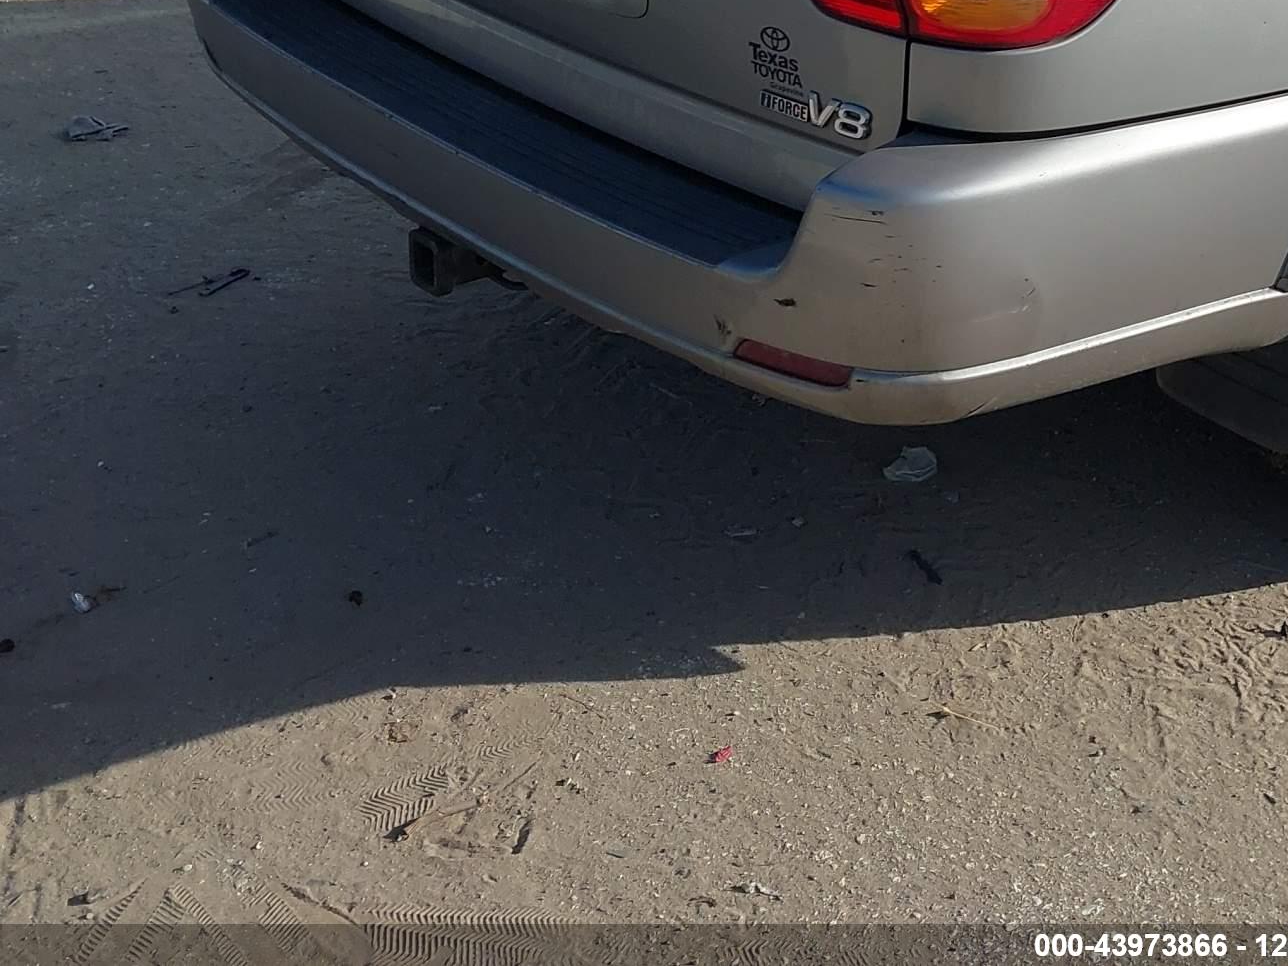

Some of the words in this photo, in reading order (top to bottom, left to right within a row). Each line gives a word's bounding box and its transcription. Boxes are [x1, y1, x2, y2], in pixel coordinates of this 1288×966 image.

[748, 41, 800, 73] Texas
[750, 60, 803, 89] TOYOTA
[808, 90, 873, 140] V8
